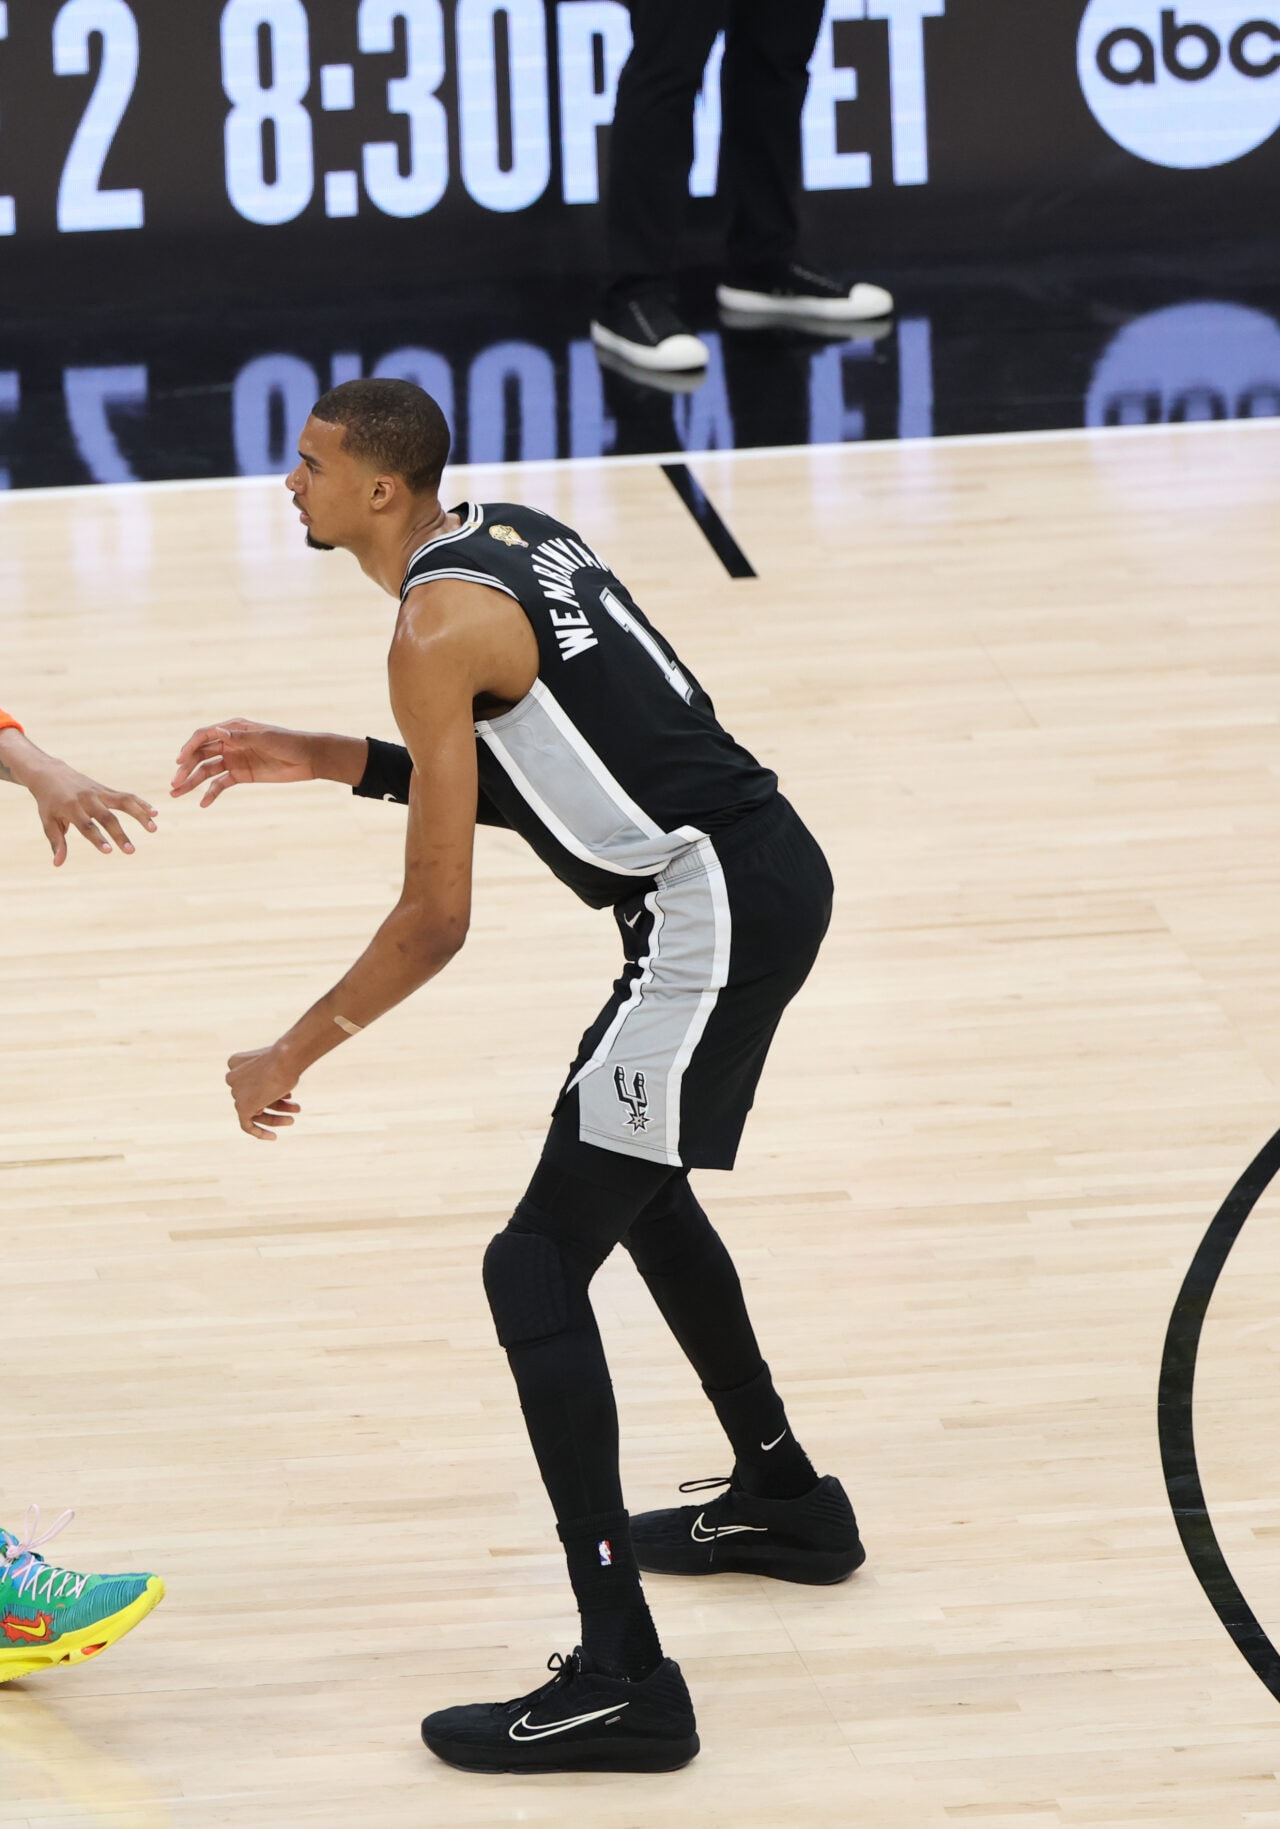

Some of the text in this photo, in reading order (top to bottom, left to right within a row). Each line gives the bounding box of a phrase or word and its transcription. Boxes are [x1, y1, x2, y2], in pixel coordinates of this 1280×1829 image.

[1095, 9, 1280, 86] abc
[51, 0, 145, 234] 2
[799, 0, 946, 191] ET
[530, 536, 610, 661] WEMBANYA
[599, 586, 694, 707] 1
